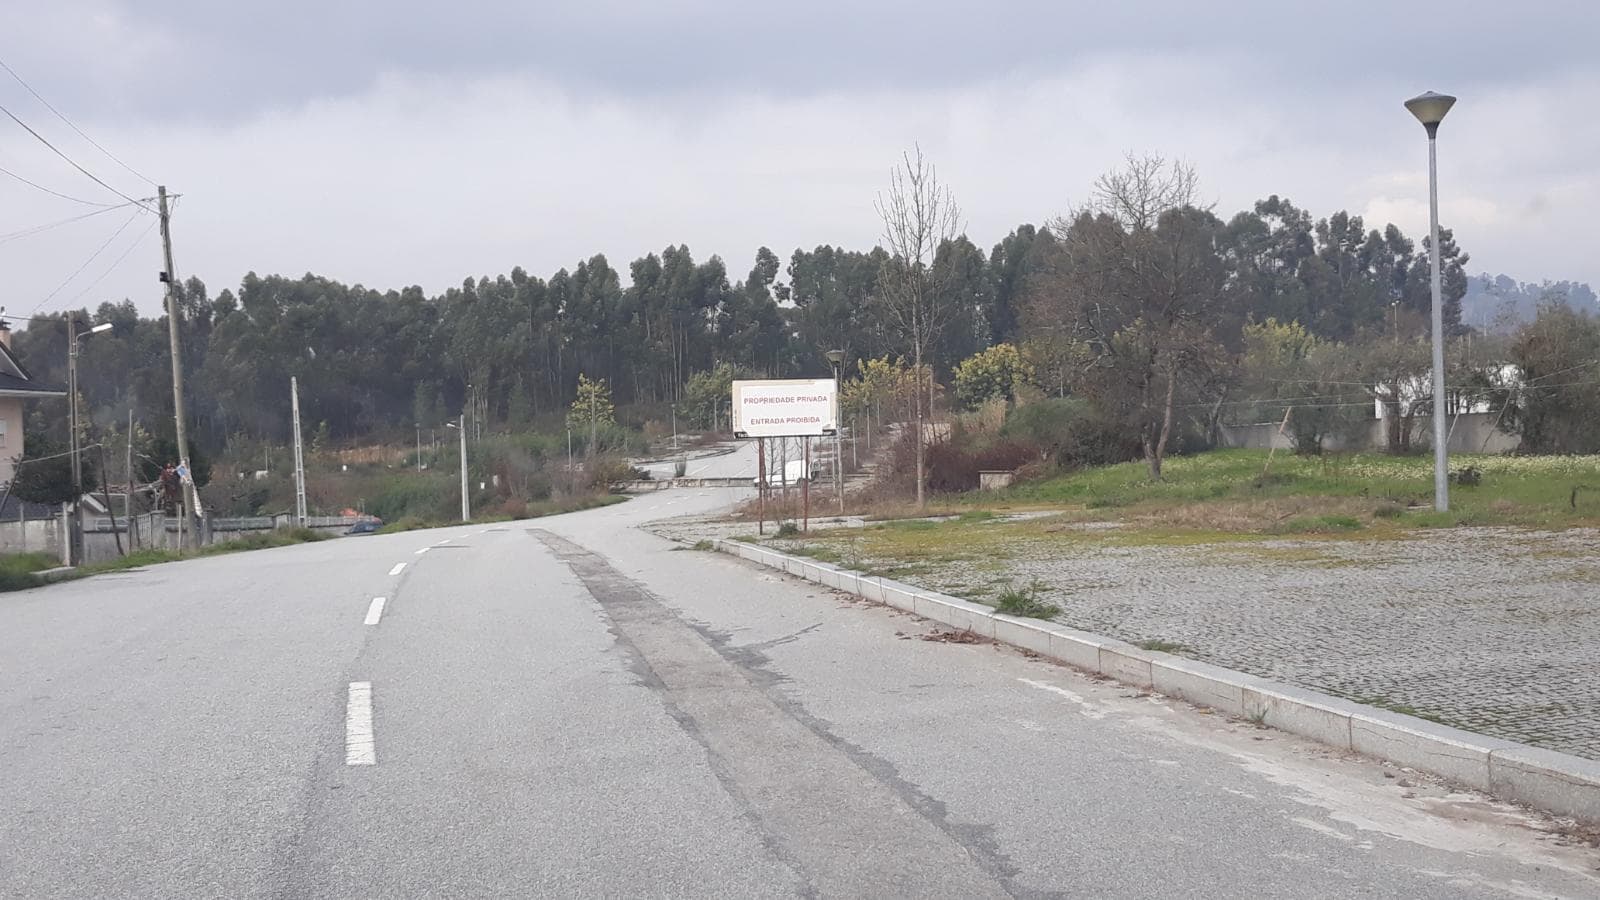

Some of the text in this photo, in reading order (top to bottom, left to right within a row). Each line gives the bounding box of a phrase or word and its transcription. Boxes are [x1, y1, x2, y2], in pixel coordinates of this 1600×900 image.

[744, 396, 795, 404] PROPRIEDADE
[750, 416, 821, 425] ENTRADA PROIBIDA
